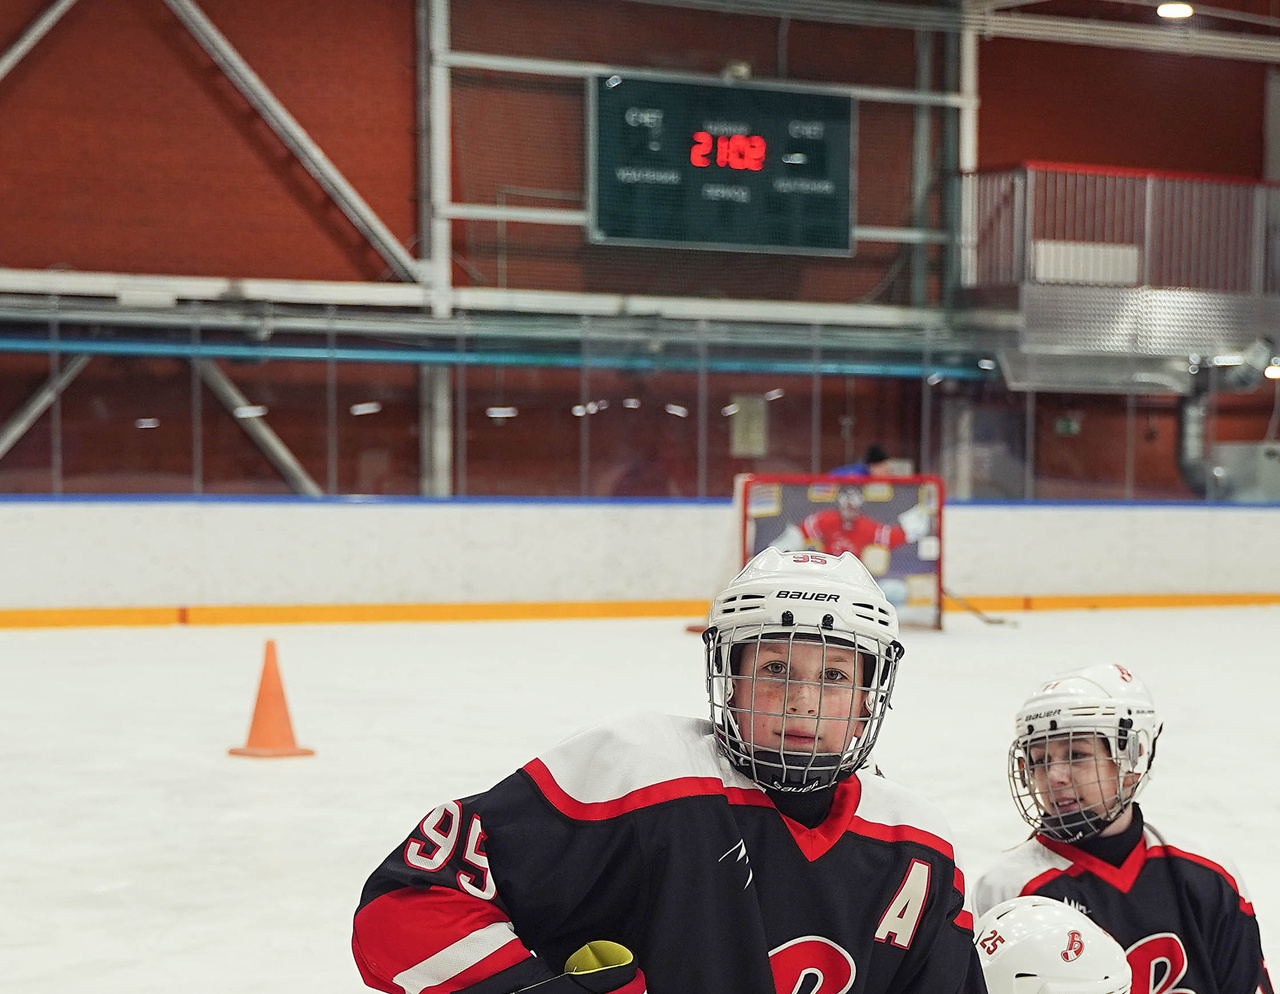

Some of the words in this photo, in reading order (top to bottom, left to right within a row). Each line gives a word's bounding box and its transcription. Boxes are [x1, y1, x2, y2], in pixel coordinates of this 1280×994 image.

[775, 590, 840, 603] BAUER
[403, 800, 498, 900] 95
[874, 858, 931, 949] A
[979, 929, 1005, 956] 25
